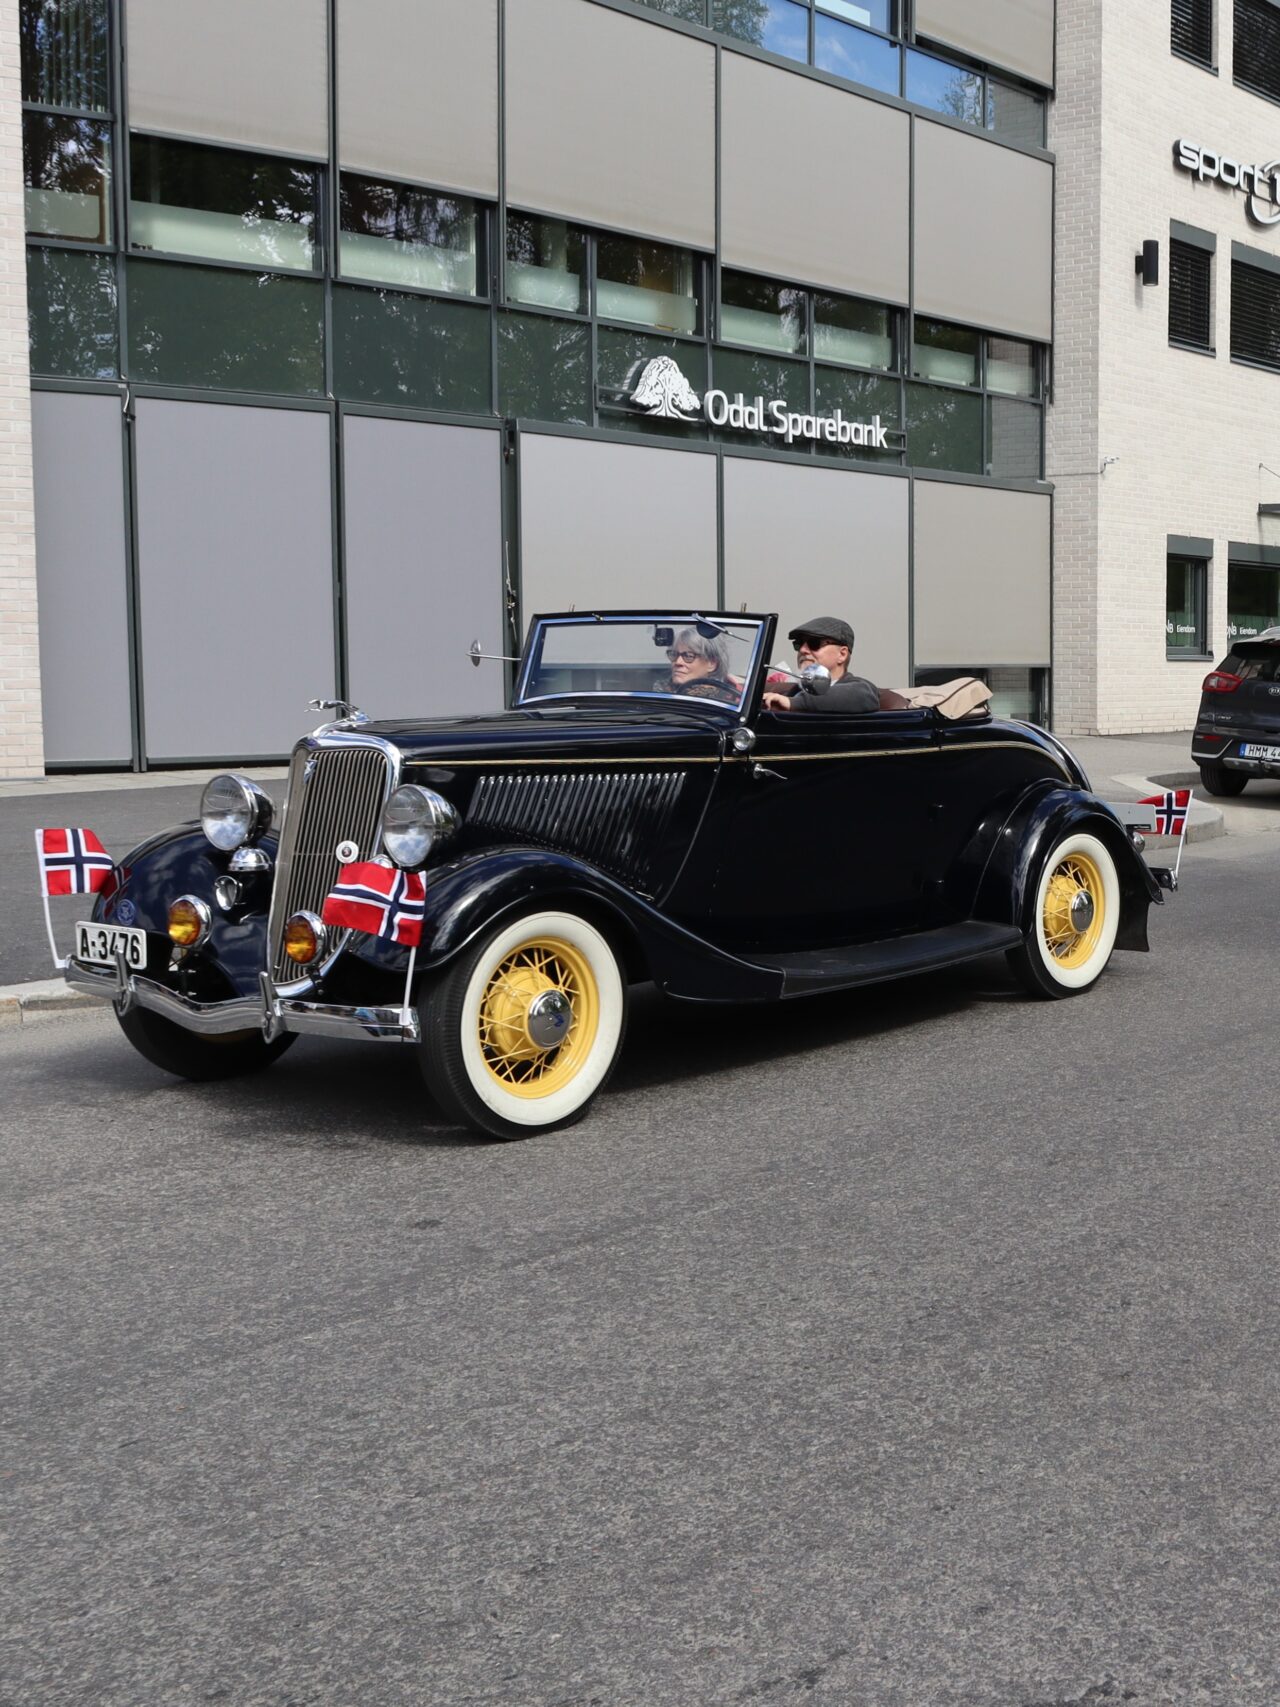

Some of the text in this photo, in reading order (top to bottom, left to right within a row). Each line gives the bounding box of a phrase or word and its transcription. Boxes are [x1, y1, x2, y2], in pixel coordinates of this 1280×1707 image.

[705, 389, 889, 449] Odal Sparebank
[1248, 745, 1269, 756] HMM
[80, 927, 141, 965] A-3476
